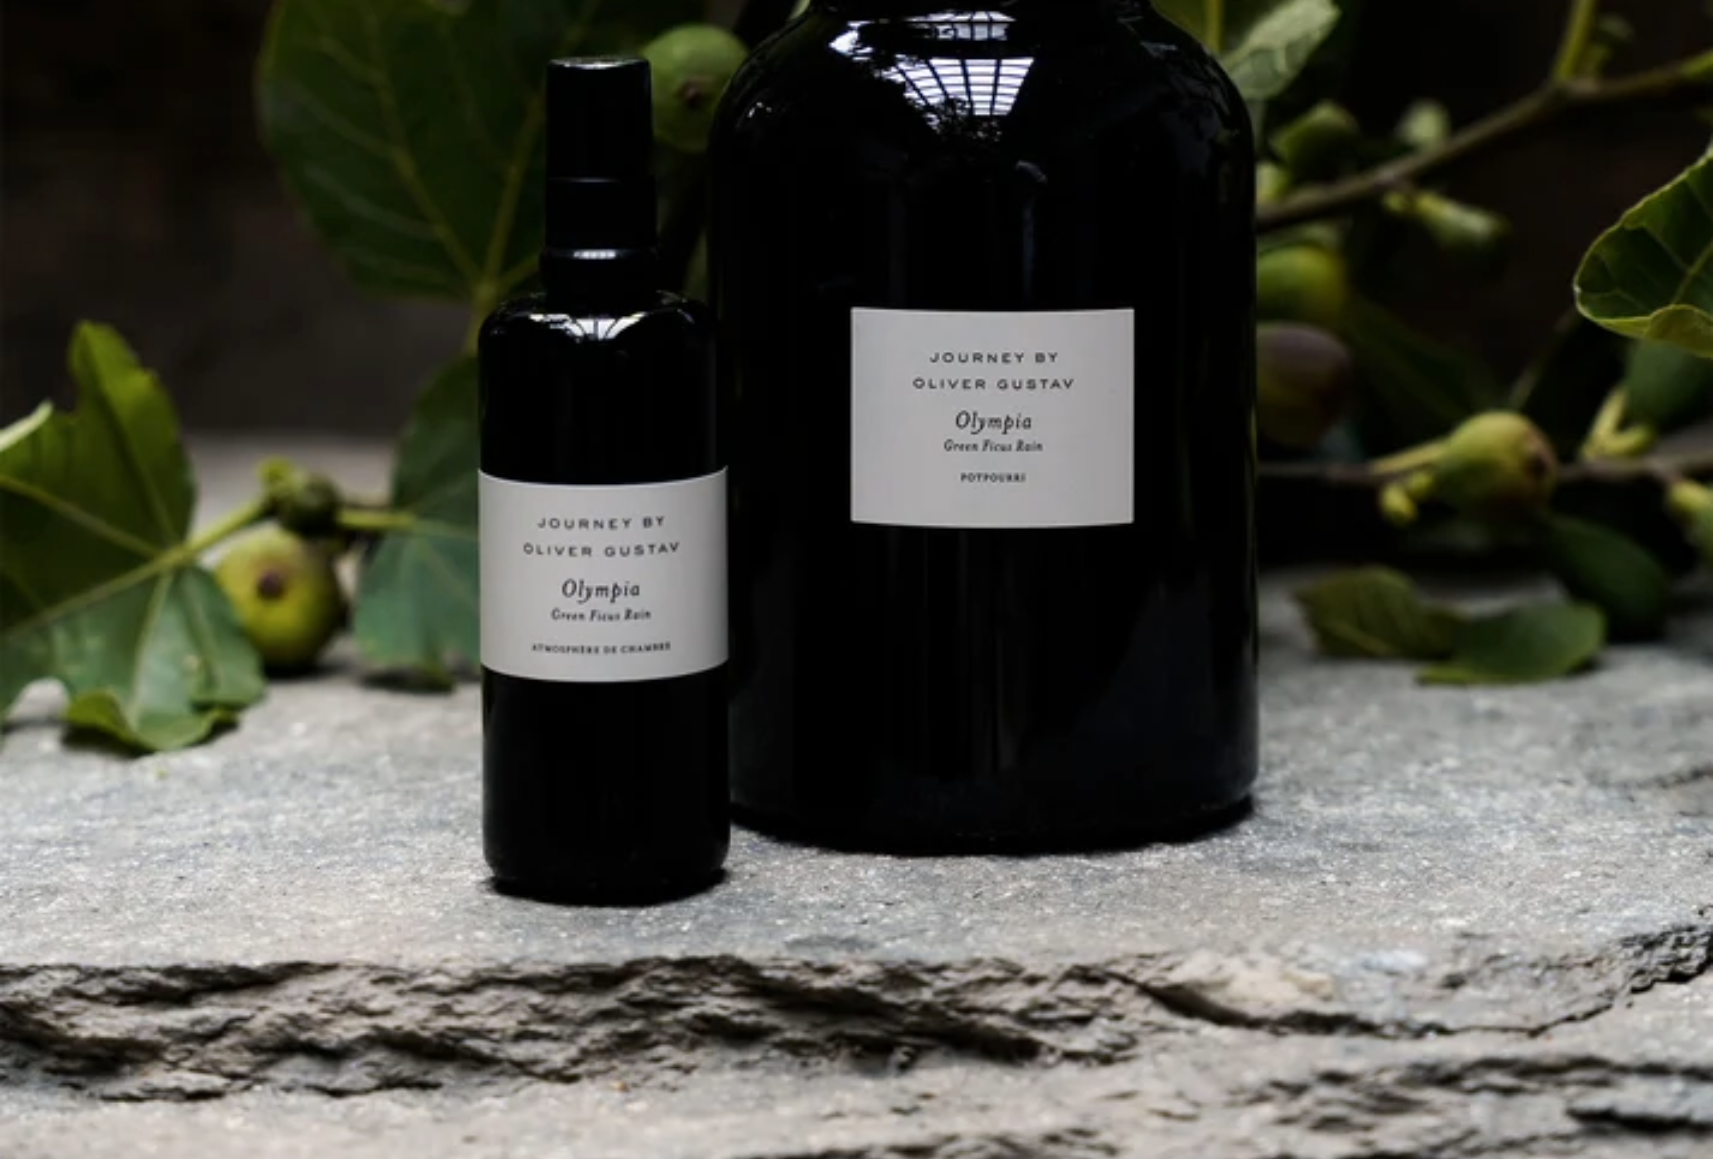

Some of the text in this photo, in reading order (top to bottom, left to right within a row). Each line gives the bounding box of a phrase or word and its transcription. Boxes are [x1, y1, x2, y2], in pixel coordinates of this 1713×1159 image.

[929, 351, 1058, 364] JOURNEY BY
[912, 377, 1075, 391] OLIVER GUSTAV
[955, 410, 1032, 435] Olympia
[943, 438, 1043, 452] Green Ficus Rain
[960, 472, 1026, 483] POTPOURRI
[537, 515, 665, 530] JOURNEY BY
[523, 541, 680, 558] OLIVER GUSTAV
[561, 578, 641, 604] Olympia
[550, 607, 652, 622] Green Ficus Rain
[603, 644, 617, 655] DE
[620, 641, 671, 654] CHAMBRE
